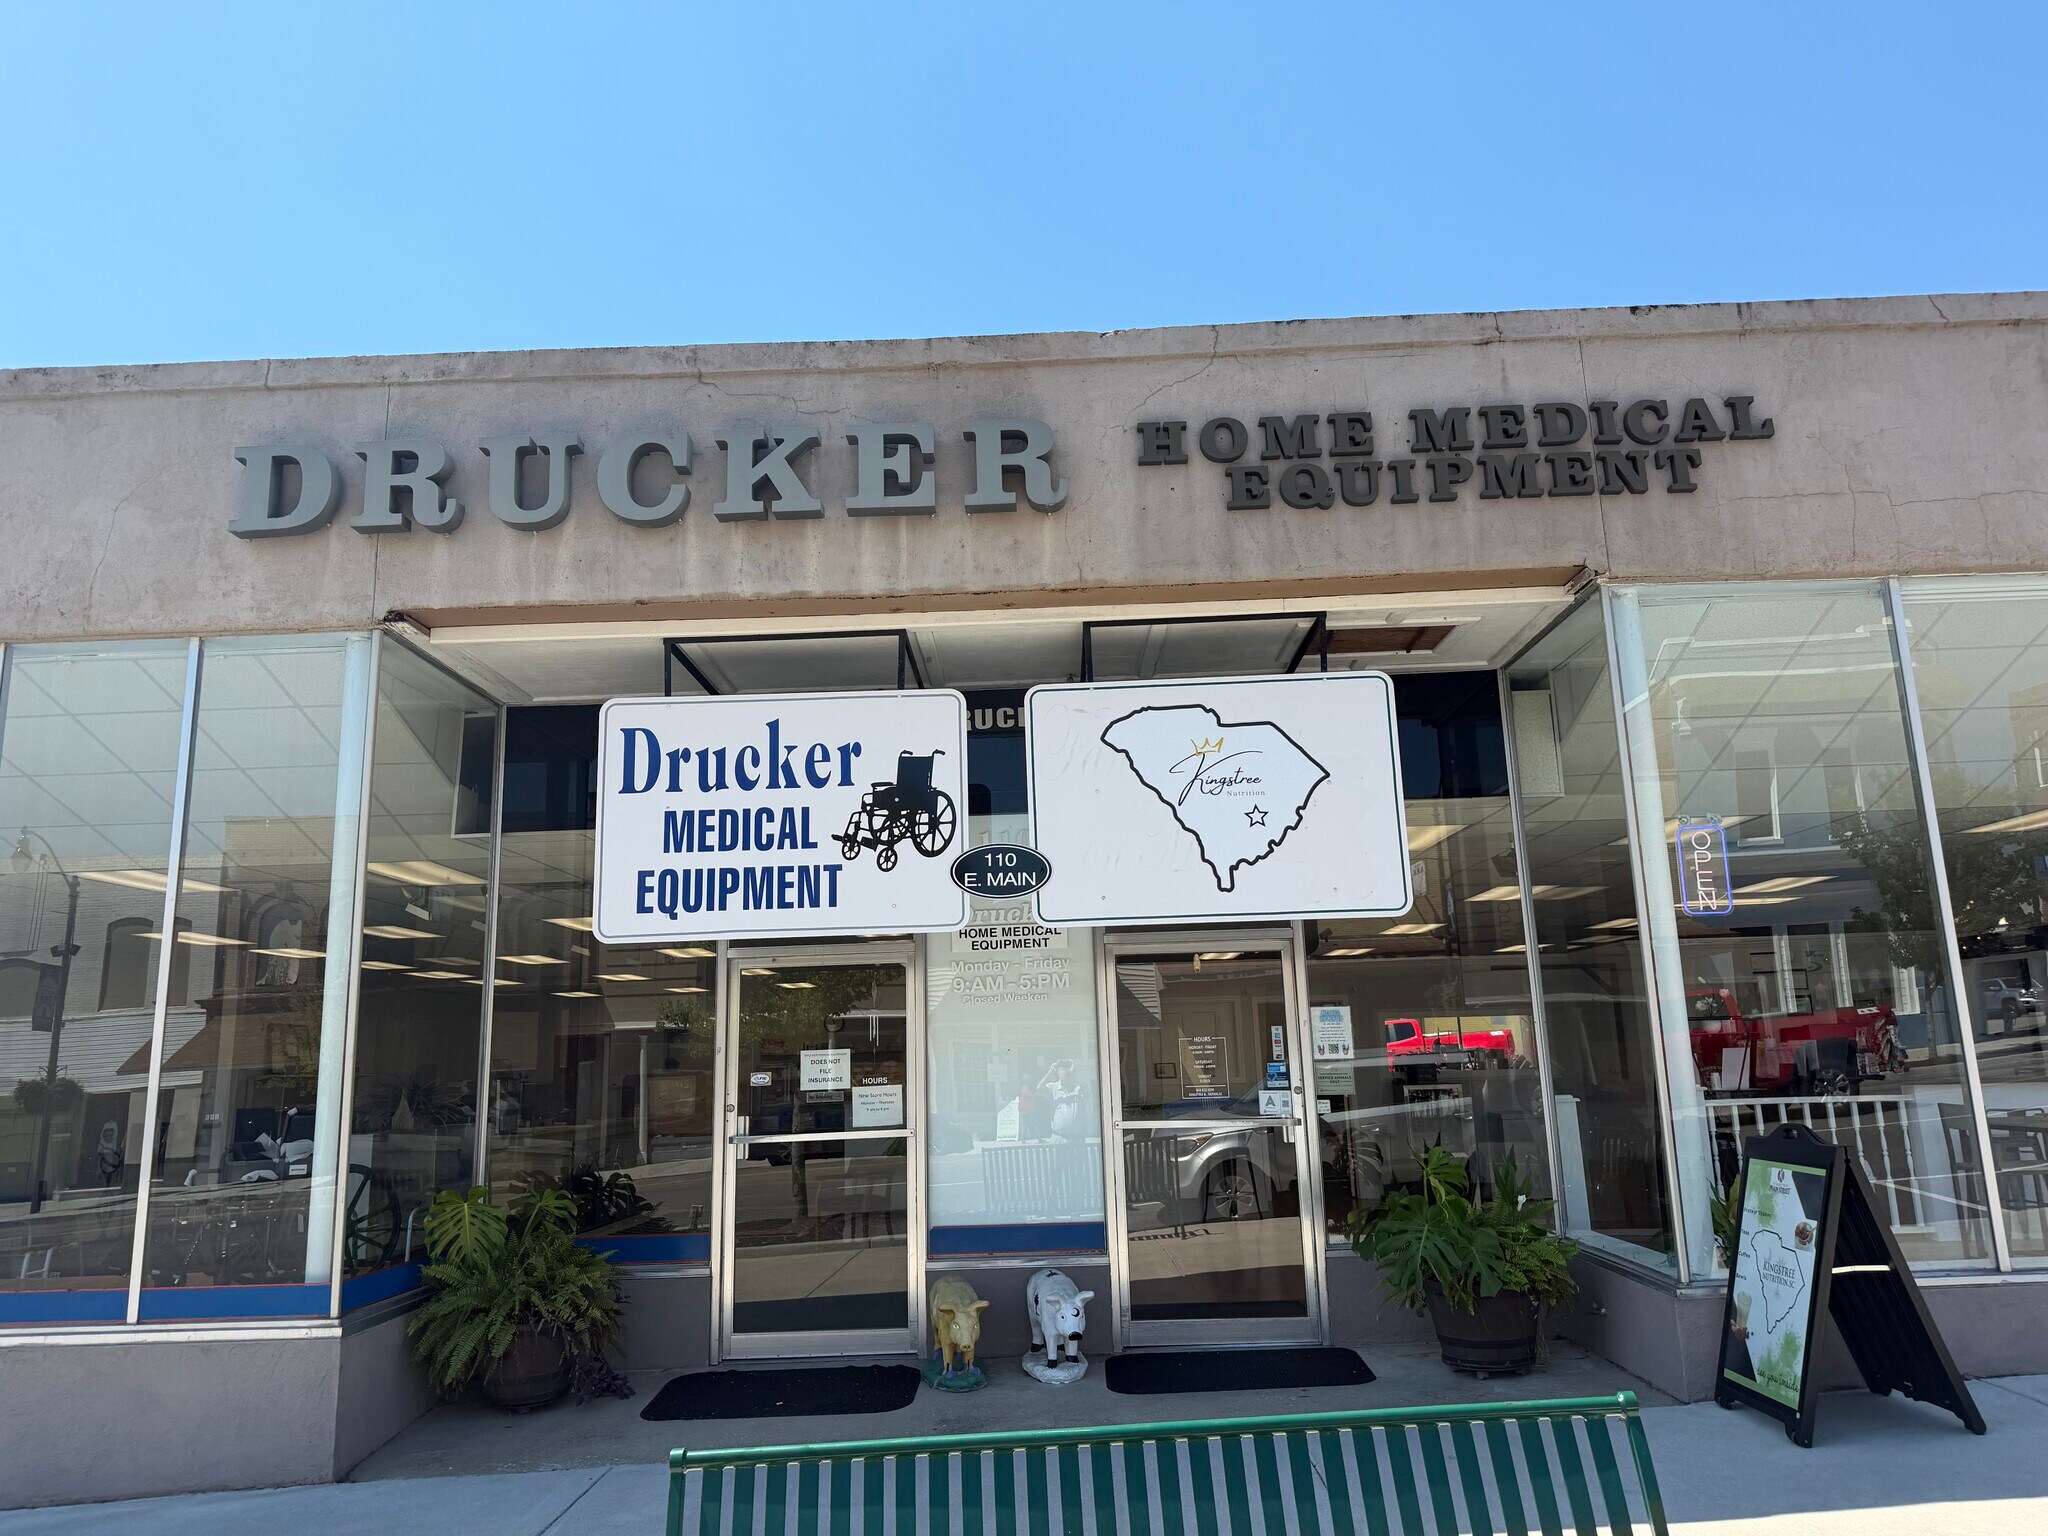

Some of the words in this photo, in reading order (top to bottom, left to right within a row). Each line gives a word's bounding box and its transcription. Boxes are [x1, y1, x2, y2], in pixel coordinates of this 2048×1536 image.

[1137, 412, 1374, 466] HOME
[1408, 396, 1774, 453] MEDICAL
[228, 417, 1068, 538] DRUCKER
[1226, 449, 1702, 511] EQUIPMENT
[618, 718, 862, 795] Drucker
[1169, 751, 1263, 806] Kingstree
[663, 806, 818, 854] MEDICAL
[984, 852, 1017, 867] 110
[964, 873, 982, 887] E.
[987, 871, 1037, 887] MAIN
[1692, 831, 1717, 911] OPEN
[636, 864, 843, 920] EQUIPMENT
[959, 927, 998, 939] HOME
[1001, 925, 1062, 938] MEDICAL
[971, 937, 1050, 951] EQUIPMENT
[951, 960, 1010, 974] Monday
[1024, 957, 1071, 971] Friday
[952, 974, 1005, 993] 9:AM
[1020, 972, 1070, 990] 5:PM
[962, 994, 1001, 1005] Closed
[1763, 1260, 1796, 1279] KINGSTREE
[1762, 1272, 1796, 1288] NUTRITION.SC
[1779, 1373, 1799, 1393] inside
